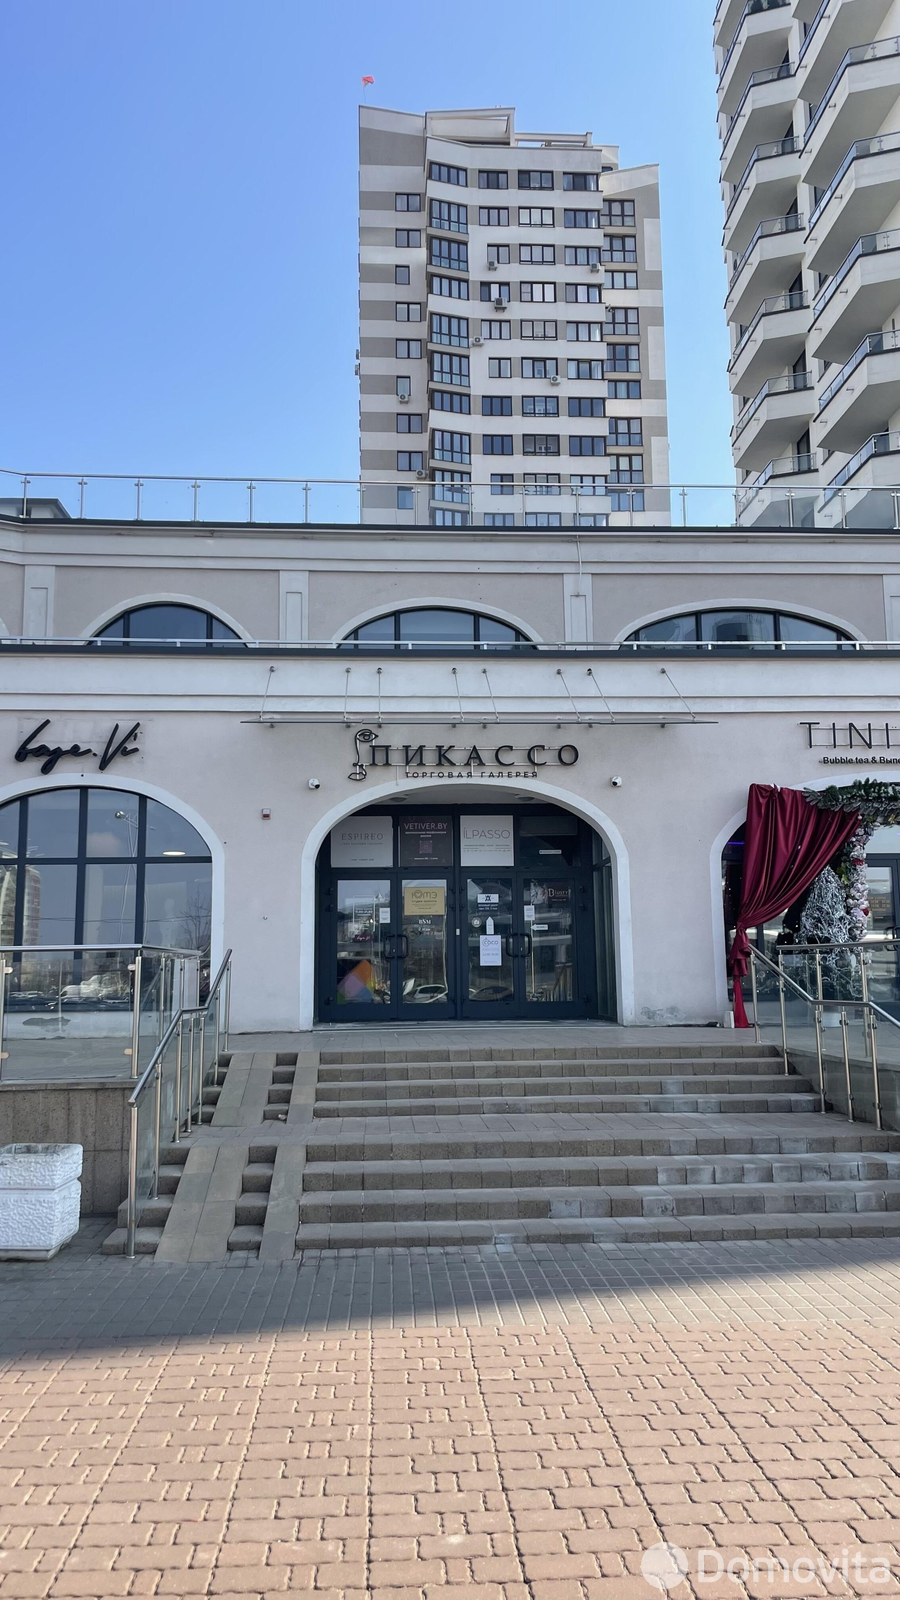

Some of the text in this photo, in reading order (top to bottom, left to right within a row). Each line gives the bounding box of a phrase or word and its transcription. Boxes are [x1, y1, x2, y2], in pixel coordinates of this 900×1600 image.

[370, 745, 579, 766] ПИКАССО
[823, 756, 854, 765] Bubble
[855, 757, 869, 765] tea
[871, 756, 878, 765] &
[405, 771, 537, 779] ТОРГОВАЯ ГАЛЕРЕЯ
[403, 822, 447, 830] VETIVER.BY
